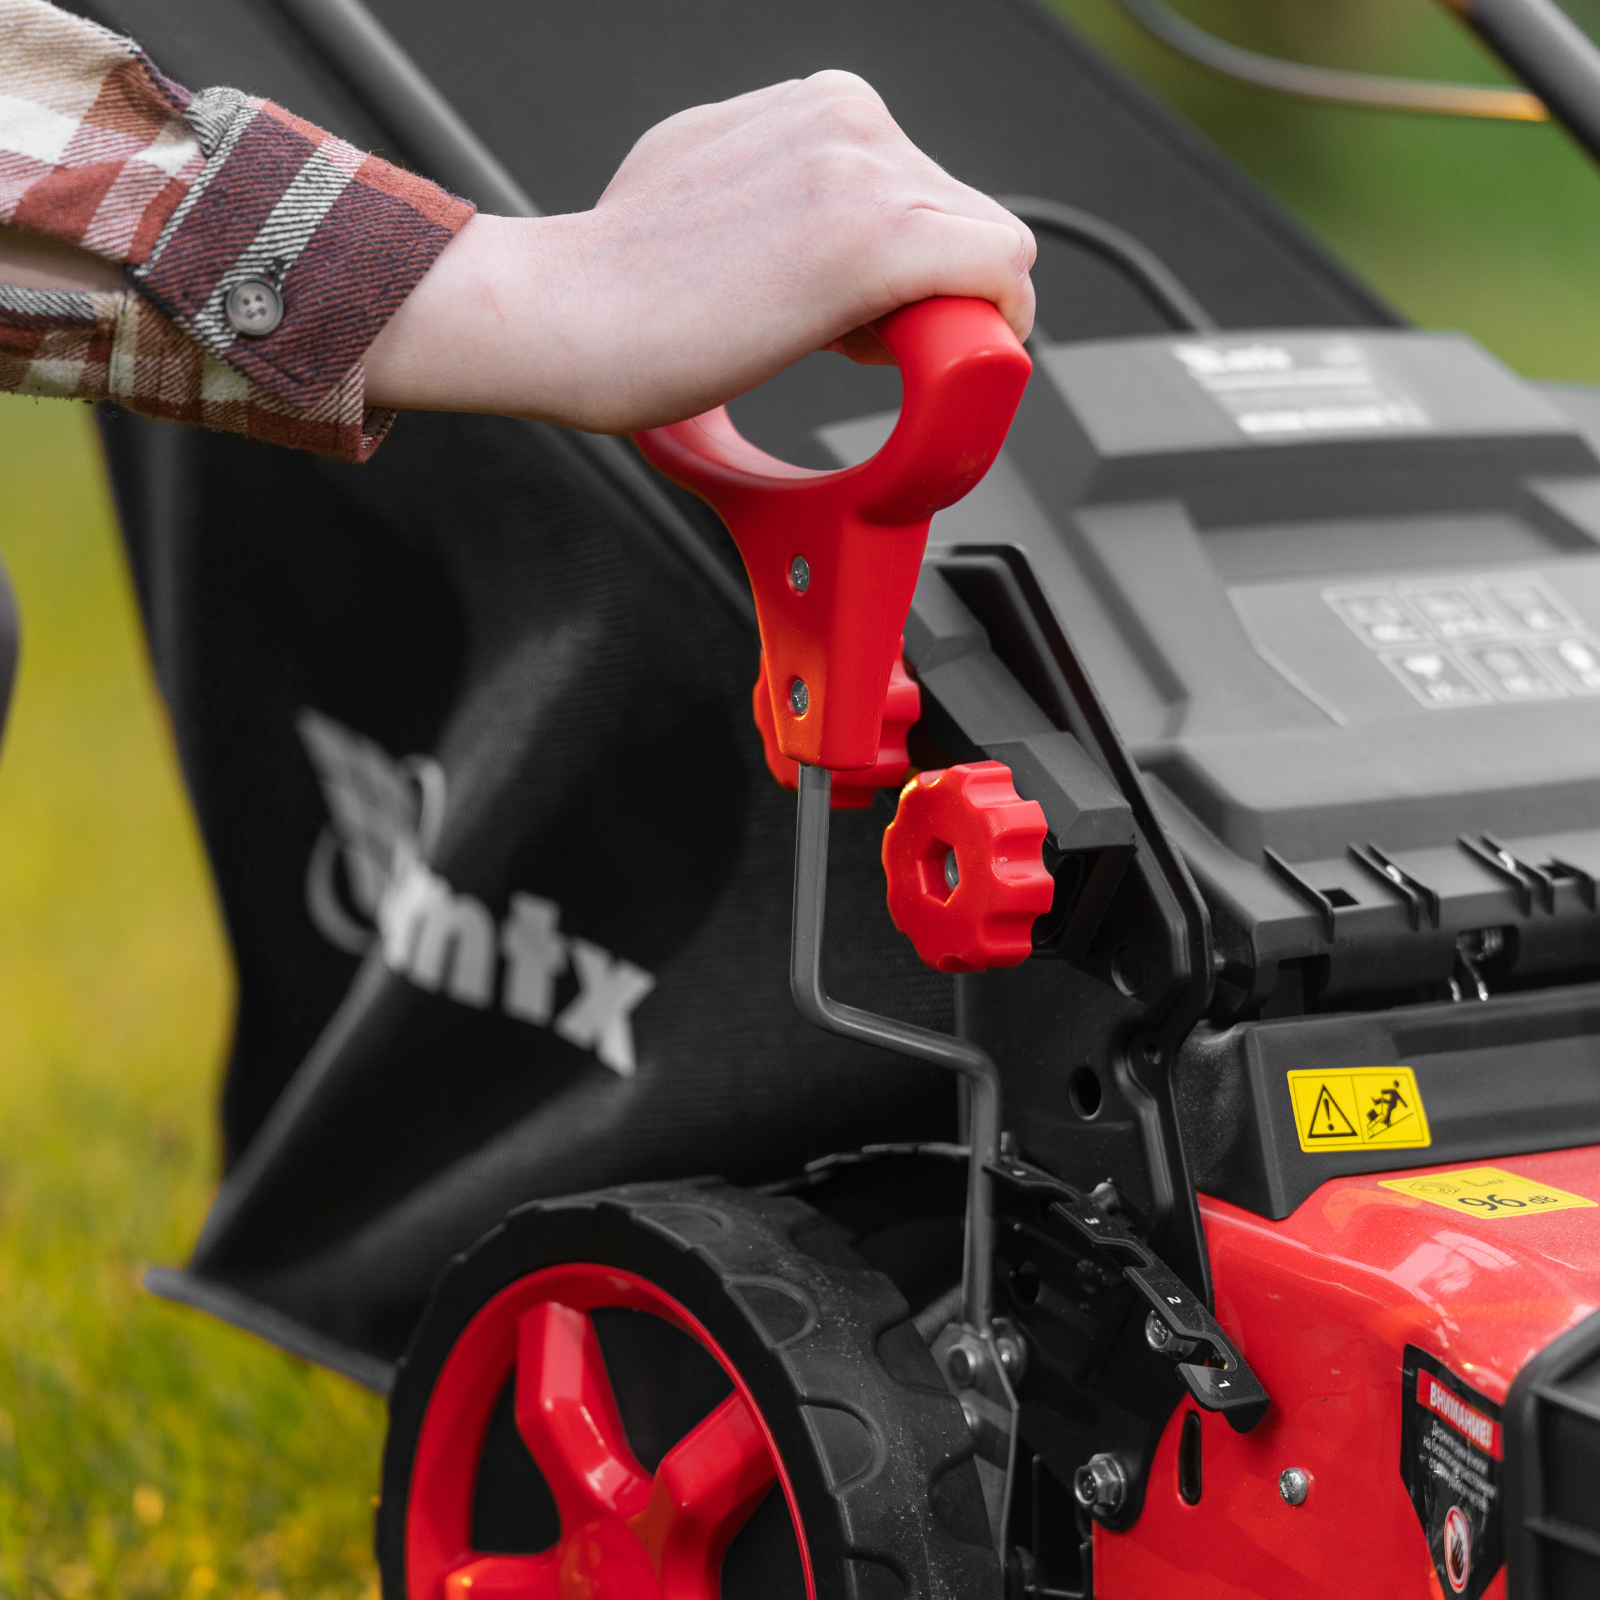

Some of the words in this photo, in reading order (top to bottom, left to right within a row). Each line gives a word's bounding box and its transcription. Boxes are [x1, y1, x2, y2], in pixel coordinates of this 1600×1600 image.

[376, 862, 656, 1078] mtx
[1457, 1194, 1528, 1211] 96
[1528, 1195, 1559, 1204] dB
[1166, 1296, 1182, 1305] 2
[1218, 1380, 1231, 1388] 1
[1430, 1381, 1493, 1450] ВНИМАНИЕ!
